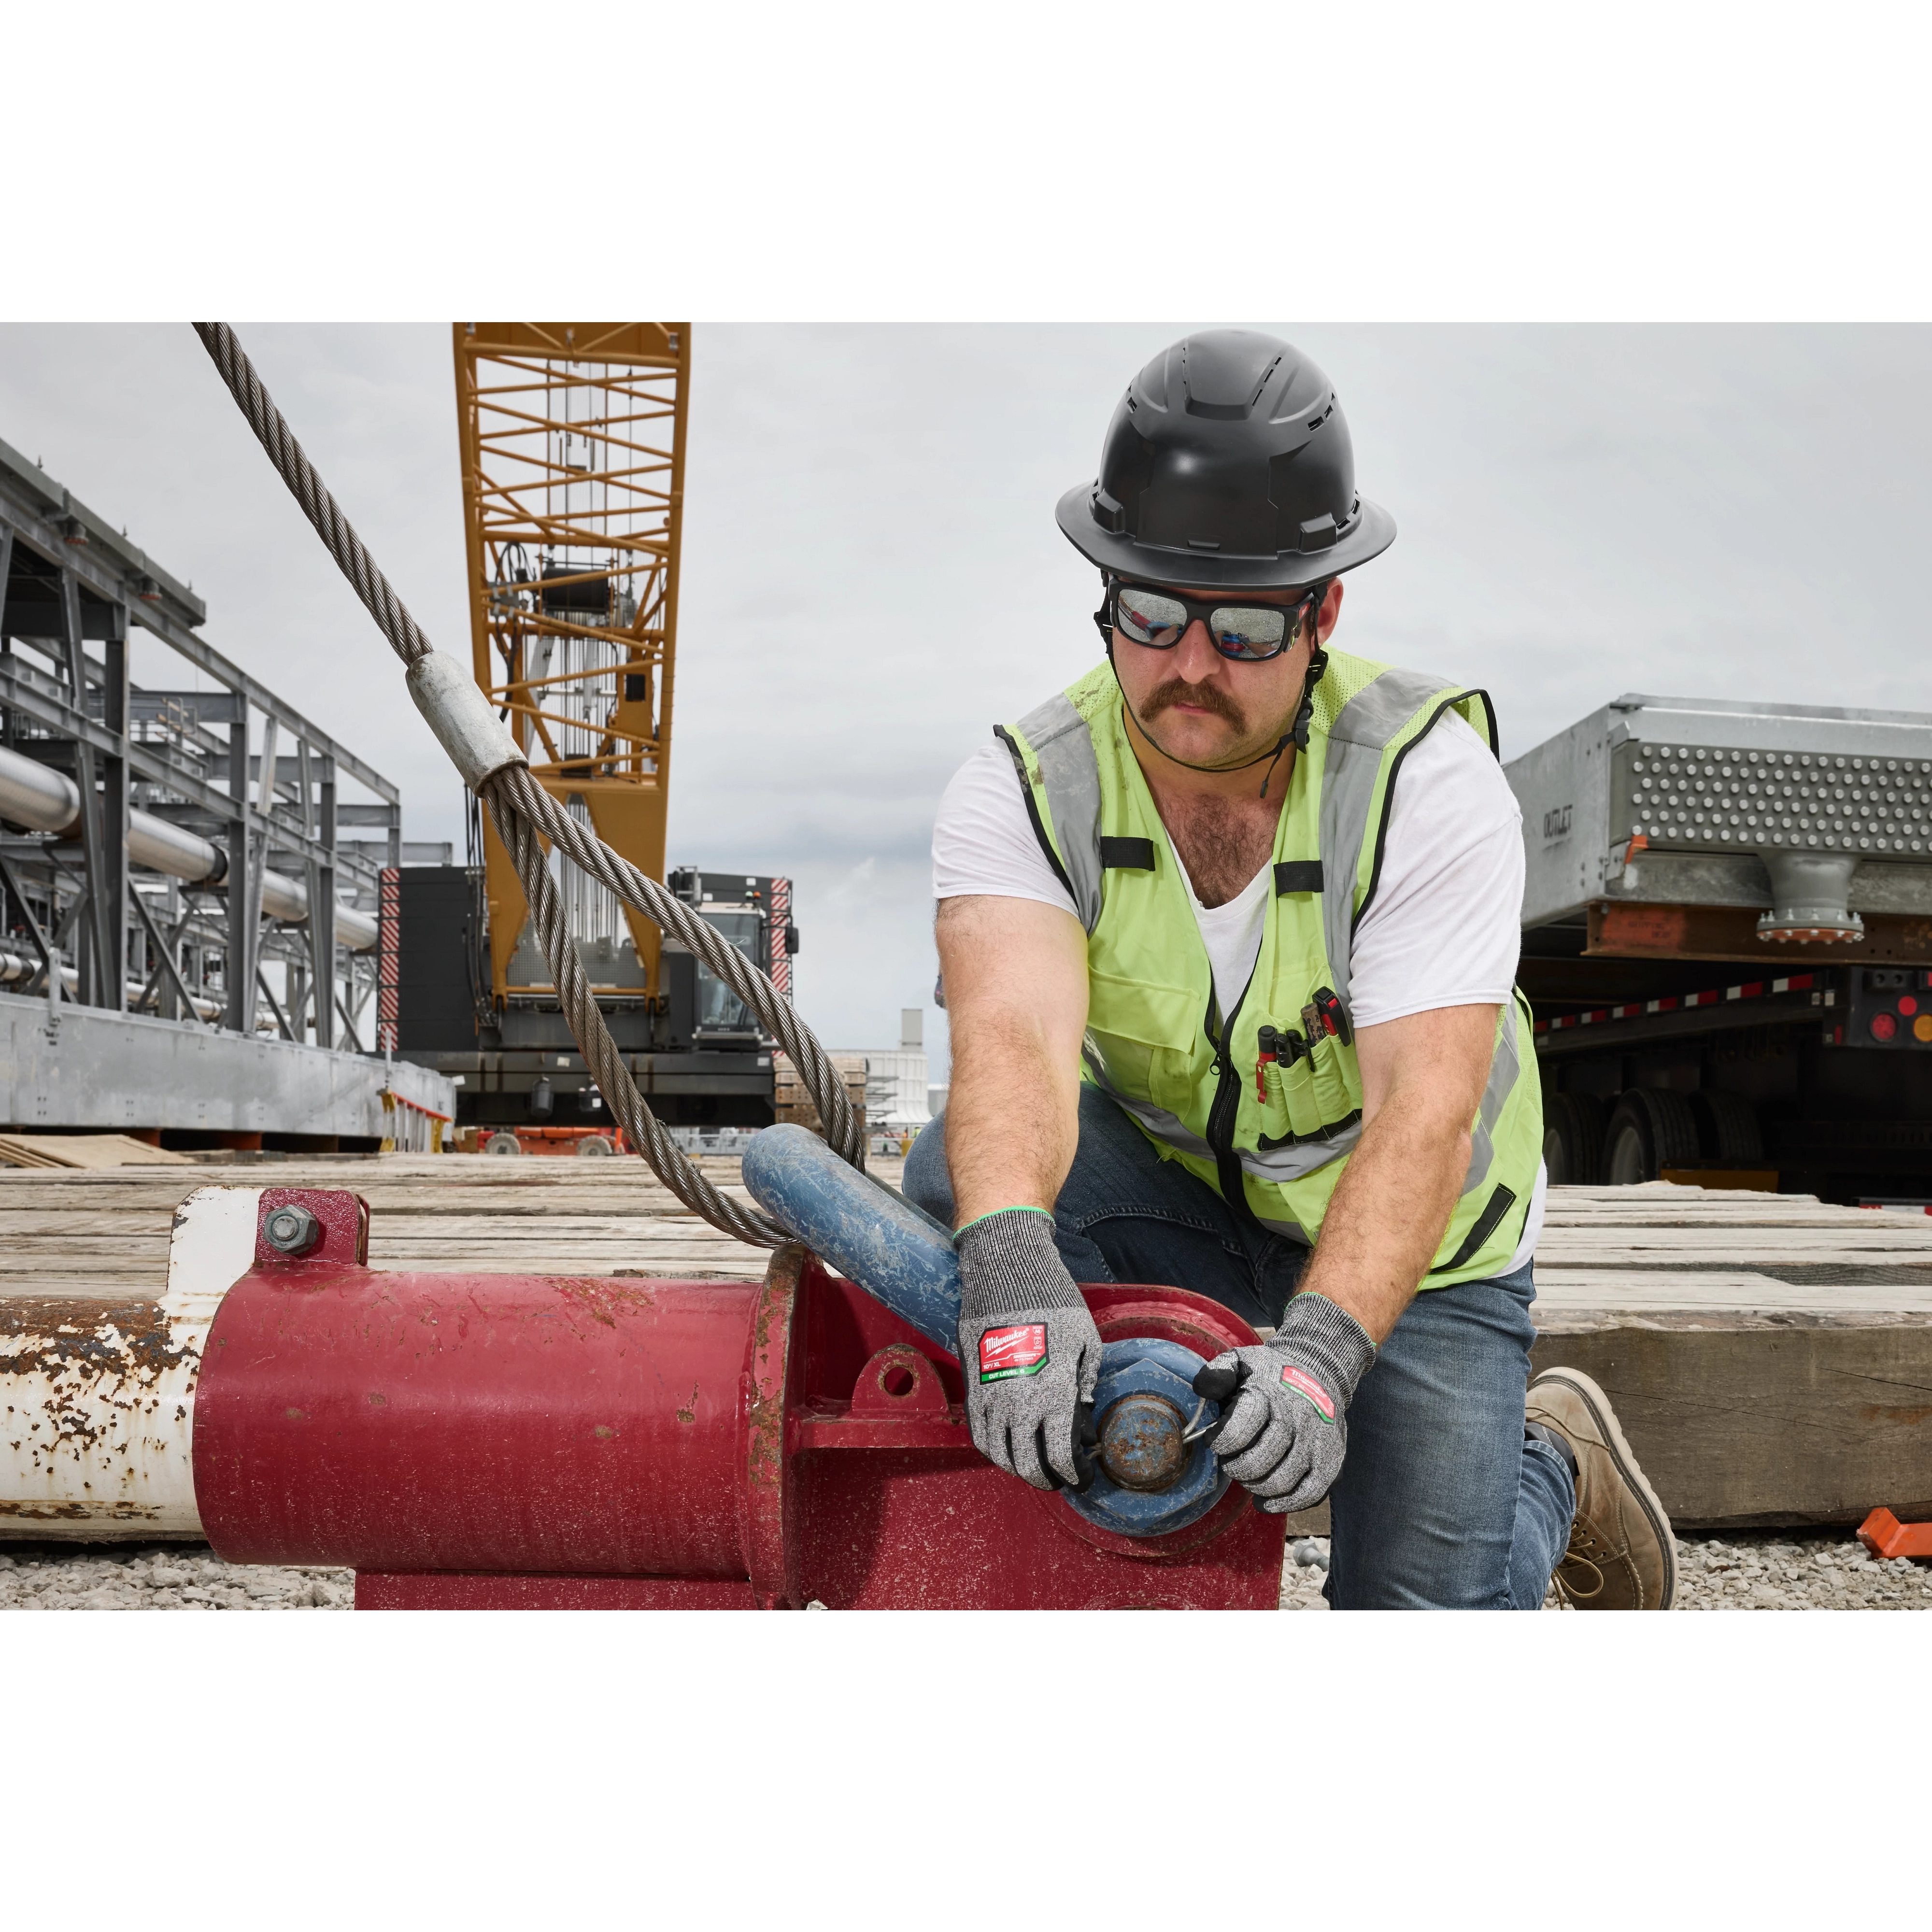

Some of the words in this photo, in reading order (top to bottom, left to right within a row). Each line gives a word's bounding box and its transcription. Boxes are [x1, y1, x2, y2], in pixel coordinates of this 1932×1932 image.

[1290, 1369, 1327, 1397] Milwaukee
[1290, 1386, 1303, 1395] CUT
[1303, 1392, 1318, 1409] LEVEL
